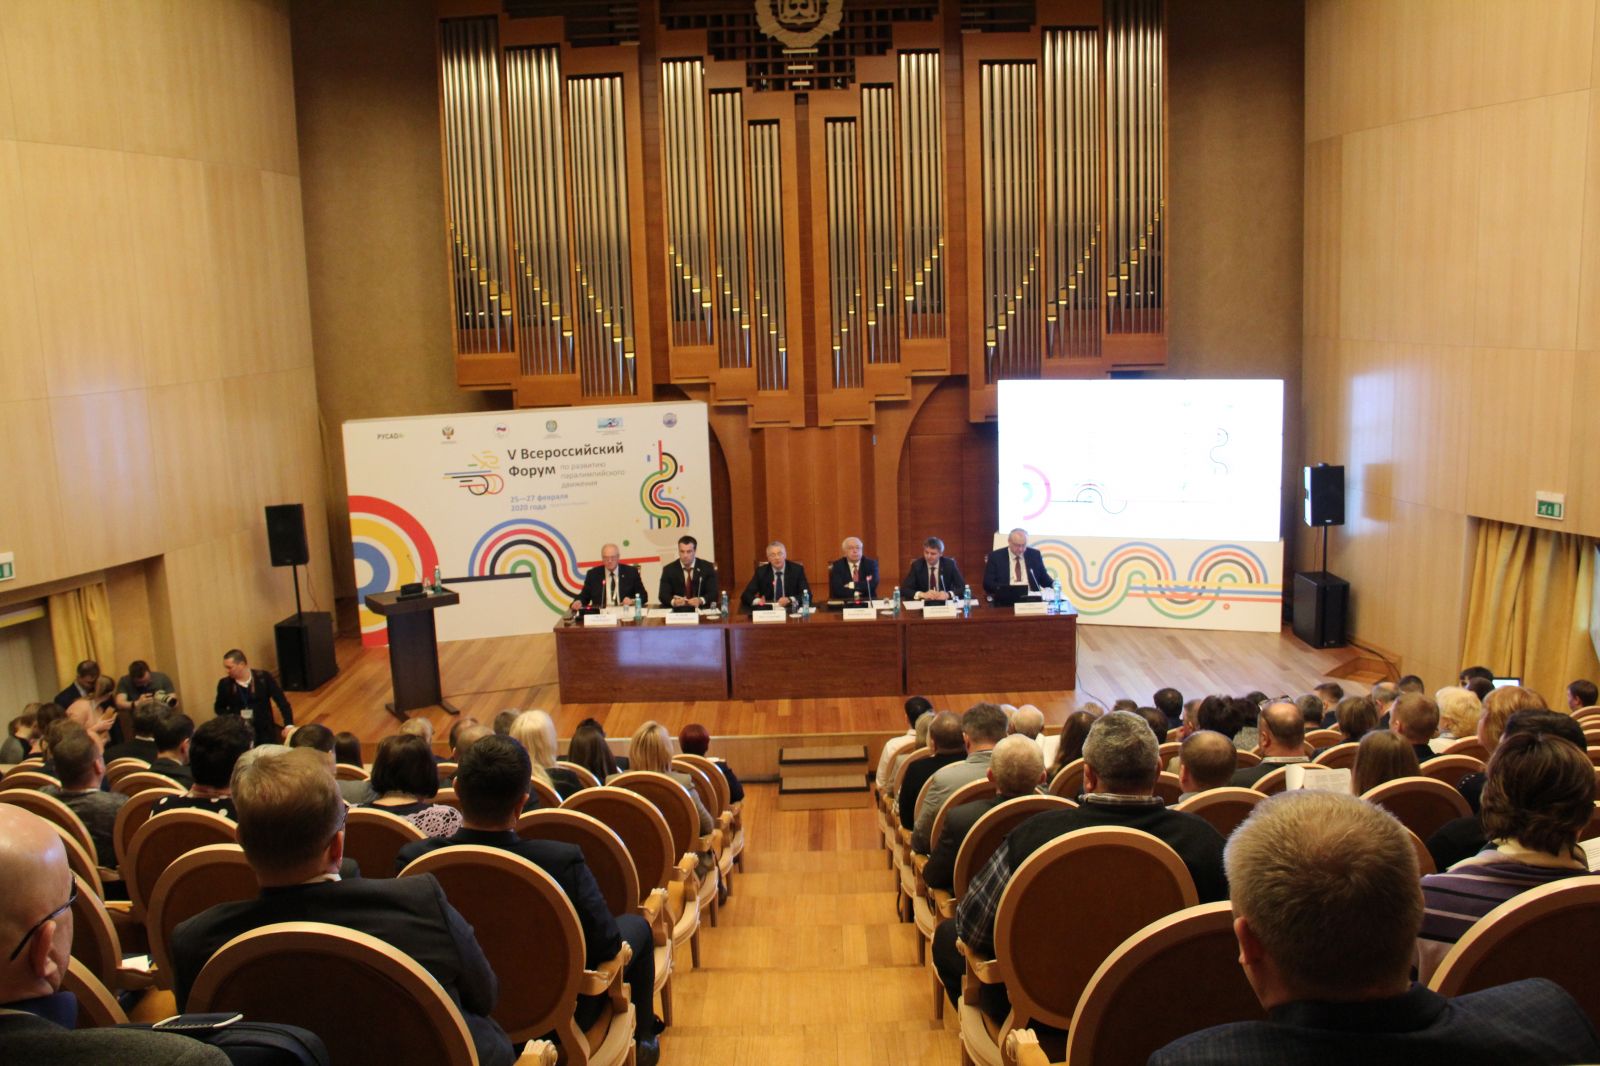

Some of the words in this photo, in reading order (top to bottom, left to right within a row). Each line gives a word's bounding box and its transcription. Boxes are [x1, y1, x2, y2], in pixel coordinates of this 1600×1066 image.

[507, 449, 516, 460] V
[521, 442, 624, 460] Всероссийский
[508, 465, 556, 478] Форум
